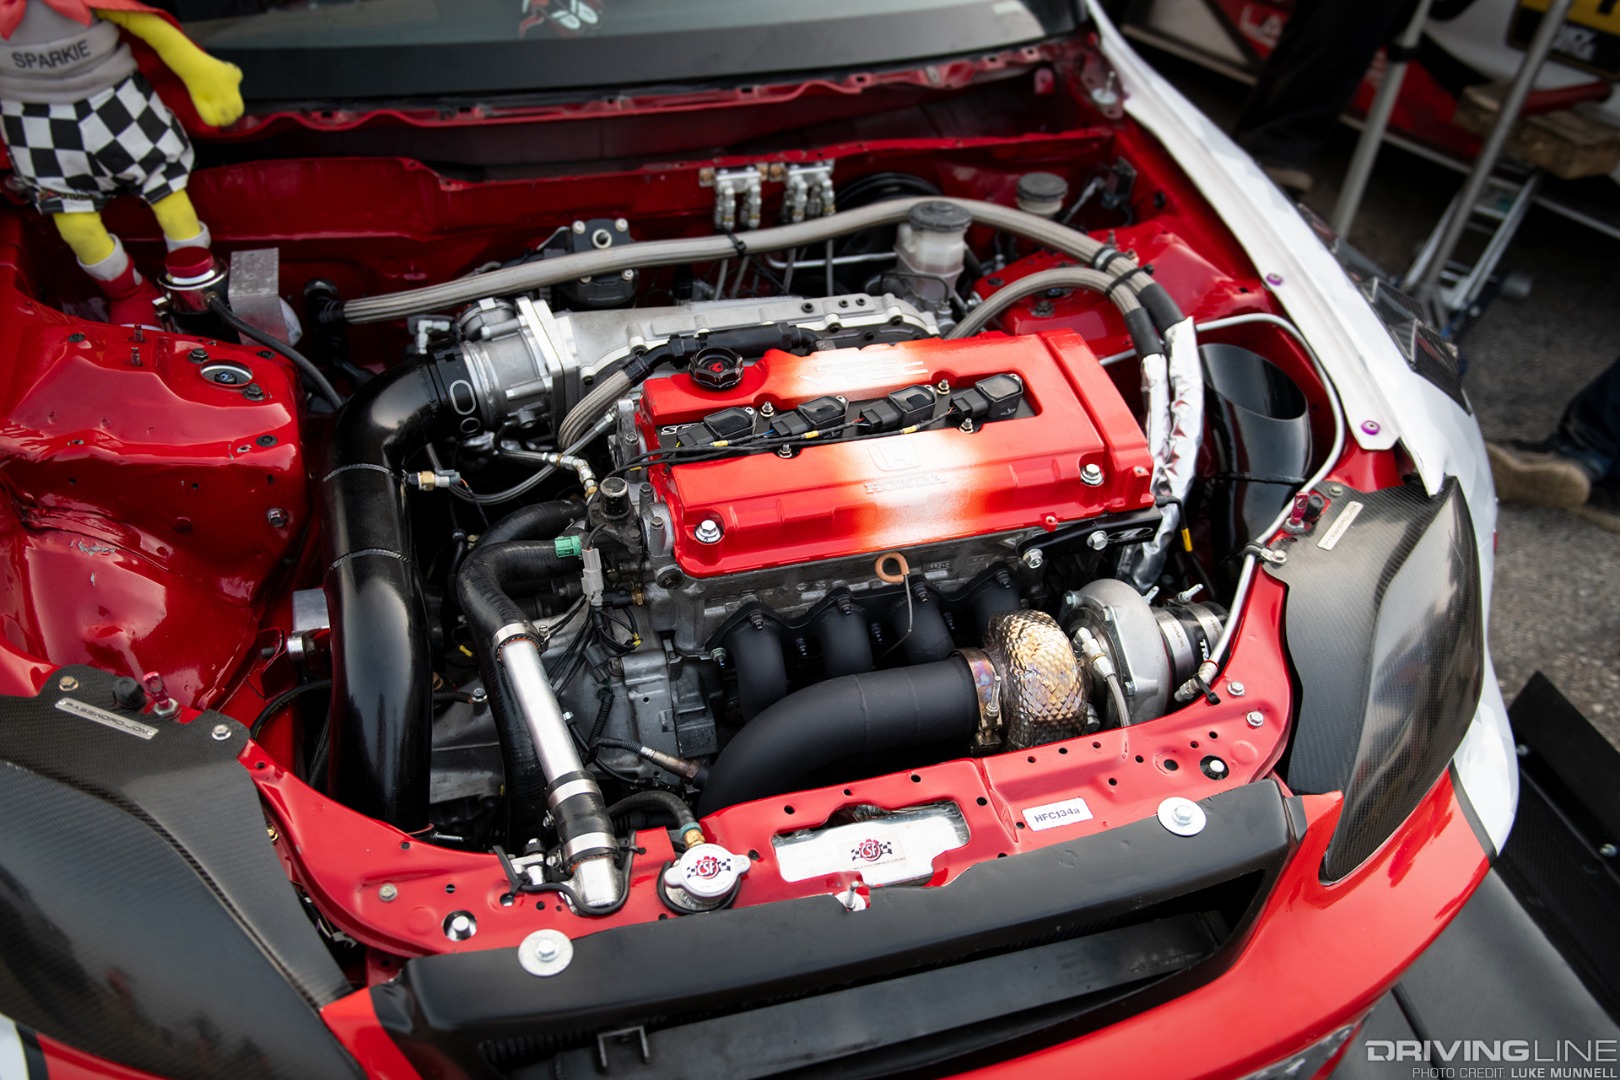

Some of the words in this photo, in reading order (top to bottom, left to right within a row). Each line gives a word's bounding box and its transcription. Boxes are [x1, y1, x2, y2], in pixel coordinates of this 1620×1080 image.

[11, 39, 91, 69] SPARKIE
[863, 472, 948, 495] HONDA
[1034, 807, 1081, 823] HFC134a
